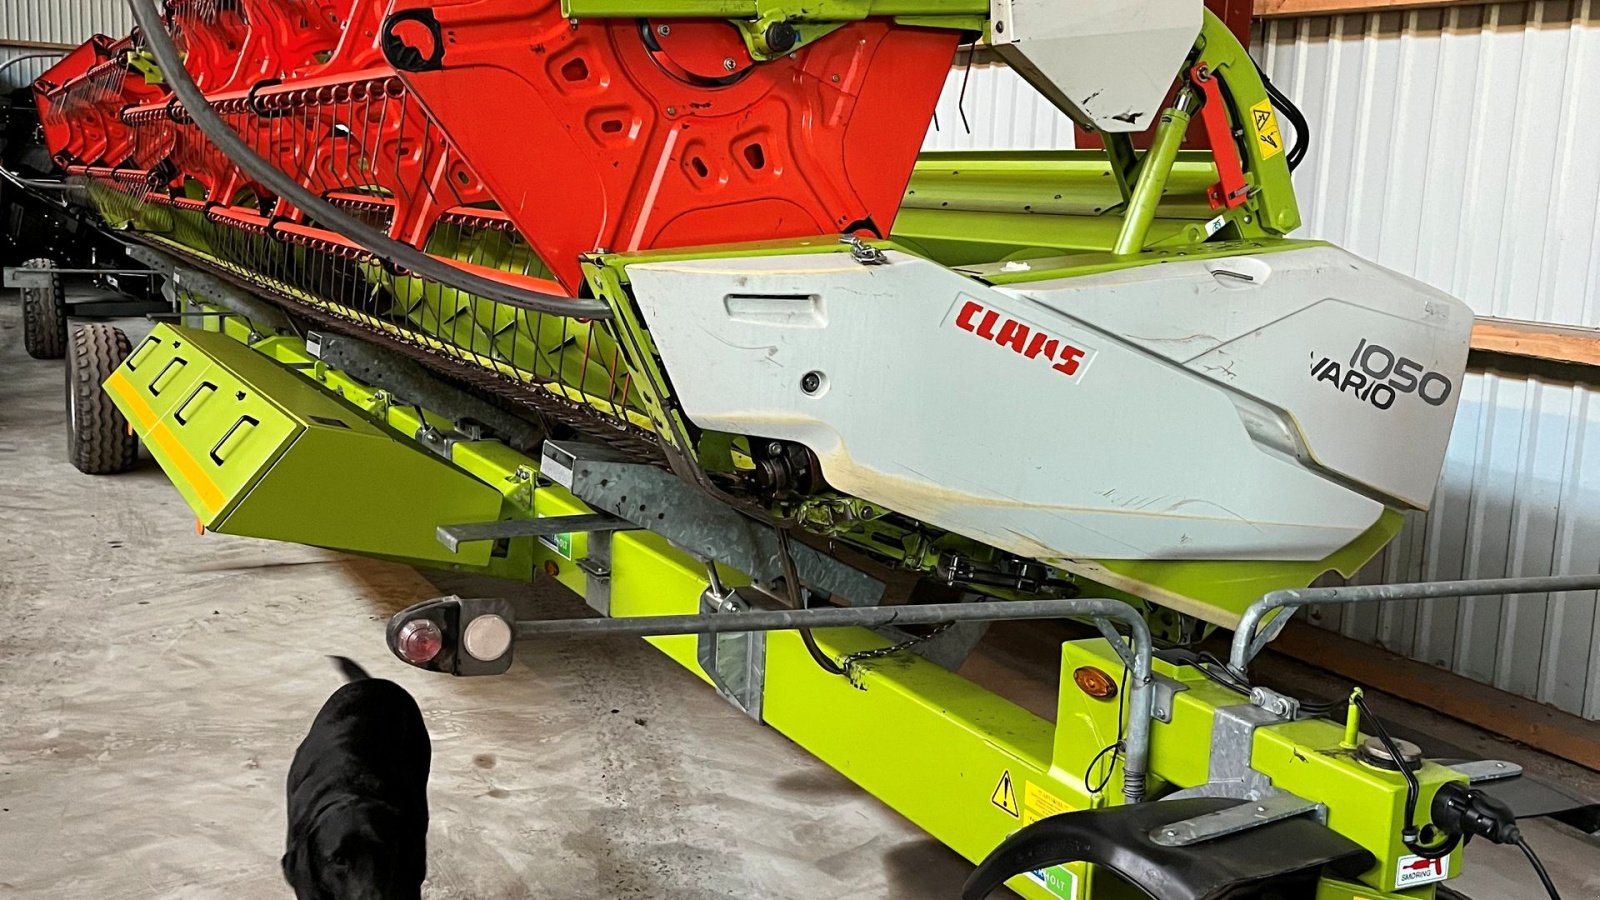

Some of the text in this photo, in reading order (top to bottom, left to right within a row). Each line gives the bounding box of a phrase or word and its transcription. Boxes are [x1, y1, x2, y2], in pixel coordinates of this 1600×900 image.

[955, 300, 1085, 376] CLAAS
[1349, 337, 1452, 406] 1050
[1310, 351, 1396, 410] VARIO
